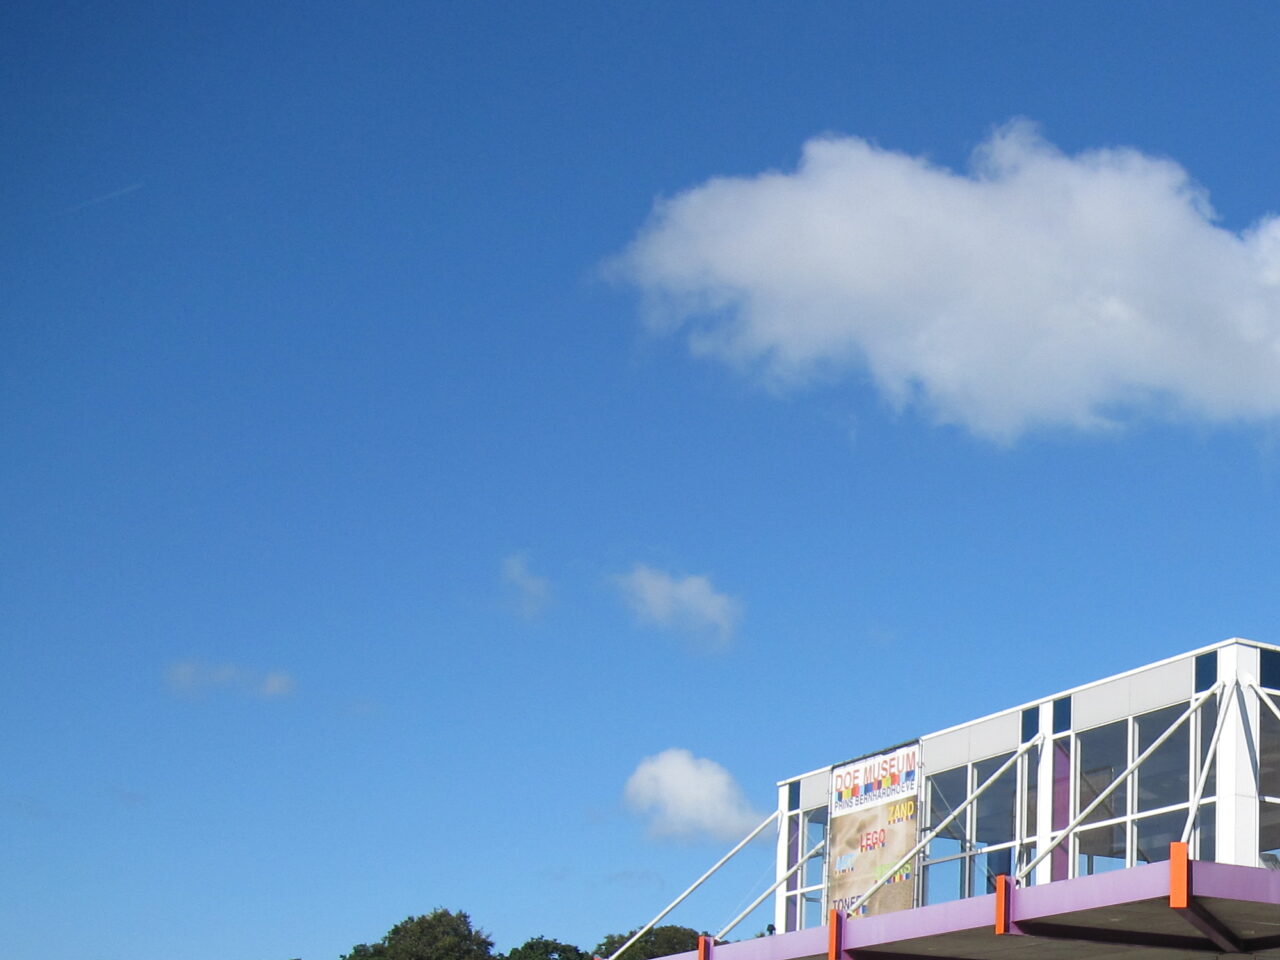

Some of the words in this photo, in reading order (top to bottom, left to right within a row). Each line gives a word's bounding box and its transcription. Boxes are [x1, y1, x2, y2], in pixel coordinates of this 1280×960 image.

[835, 769, 860, 792] DOE
[863, 751, 916, 785] MUSEUM
[835, 798, 853, 812] PRINS
[855, 781, 915, 806] BERNHARDHOEVE
[888, 801, 915, 820] ZAND
[860, 828, 886, 849] LEGO
